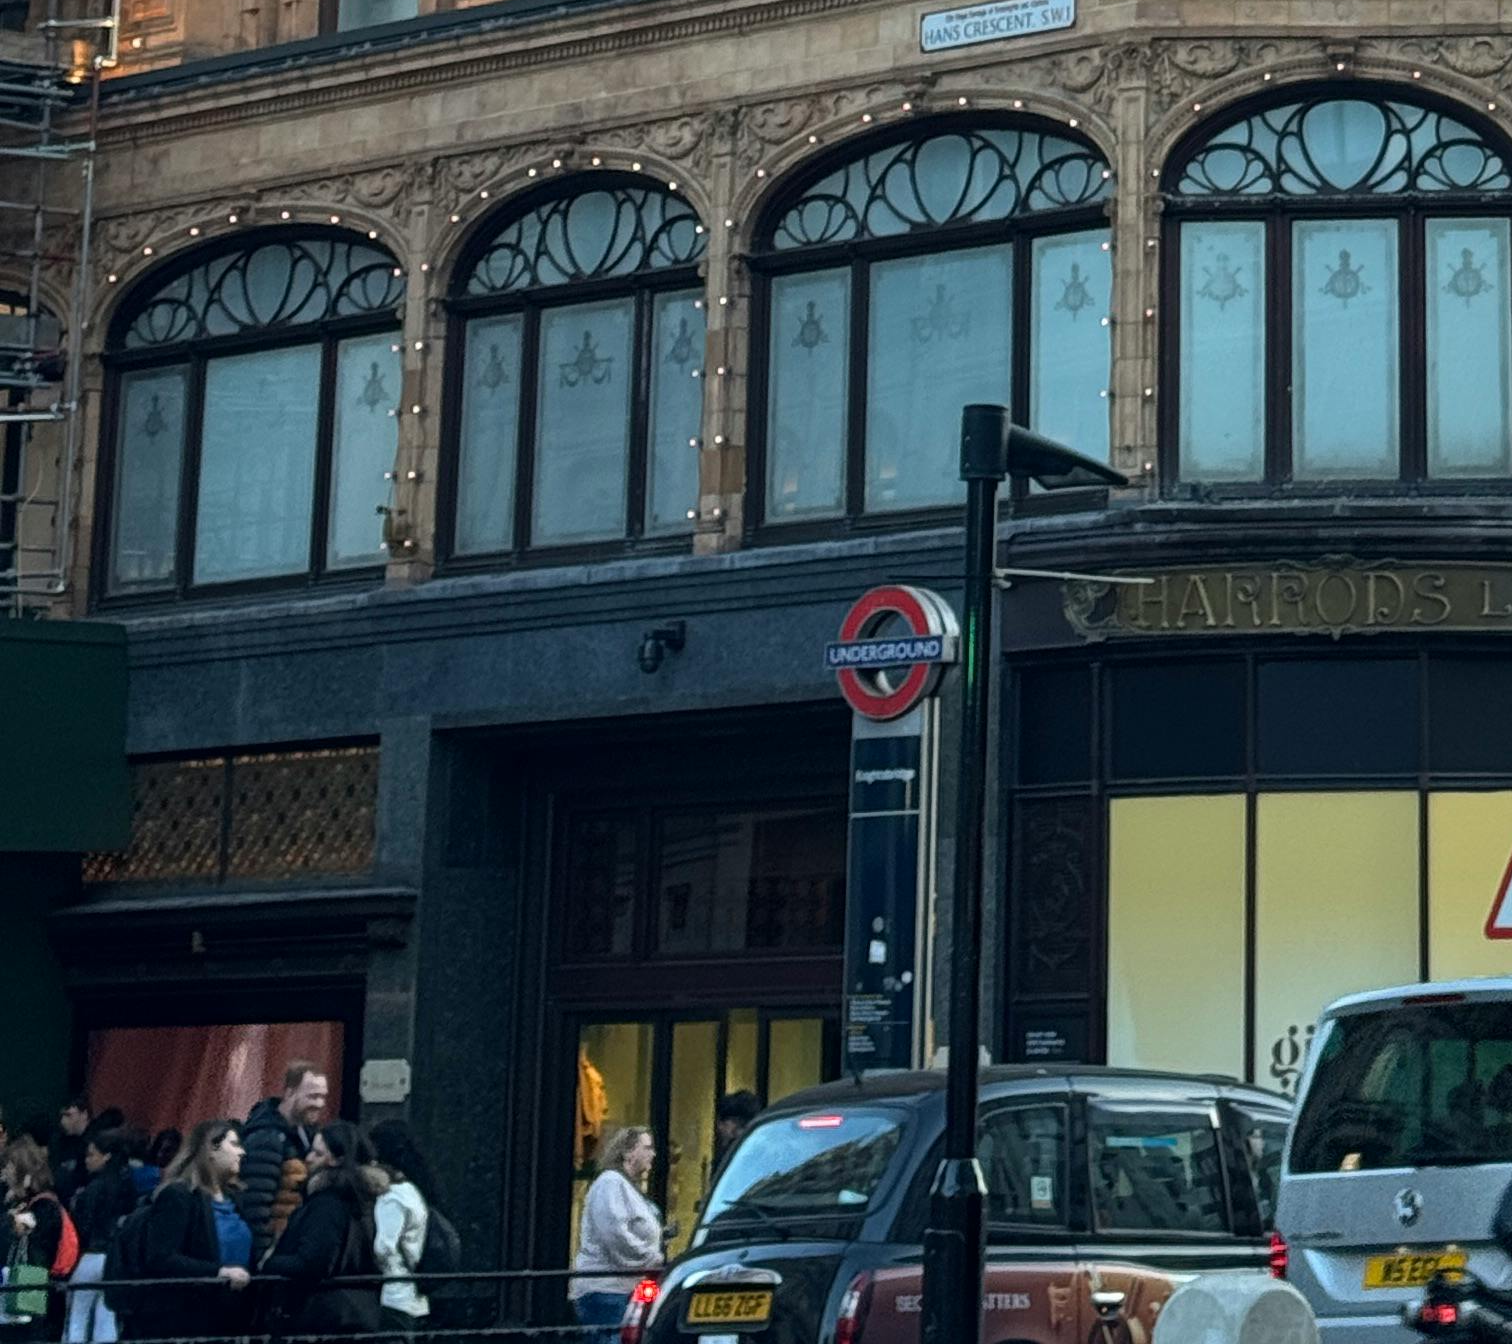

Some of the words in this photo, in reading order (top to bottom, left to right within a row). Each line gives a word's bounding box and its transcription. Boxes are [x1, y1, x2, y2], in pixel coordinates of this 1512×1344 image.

[924, 23, 961, 46] HANS
[1127, 571, 1452, 629] HARRODS
[829, 640, 939, 664] UNDERGROUND
